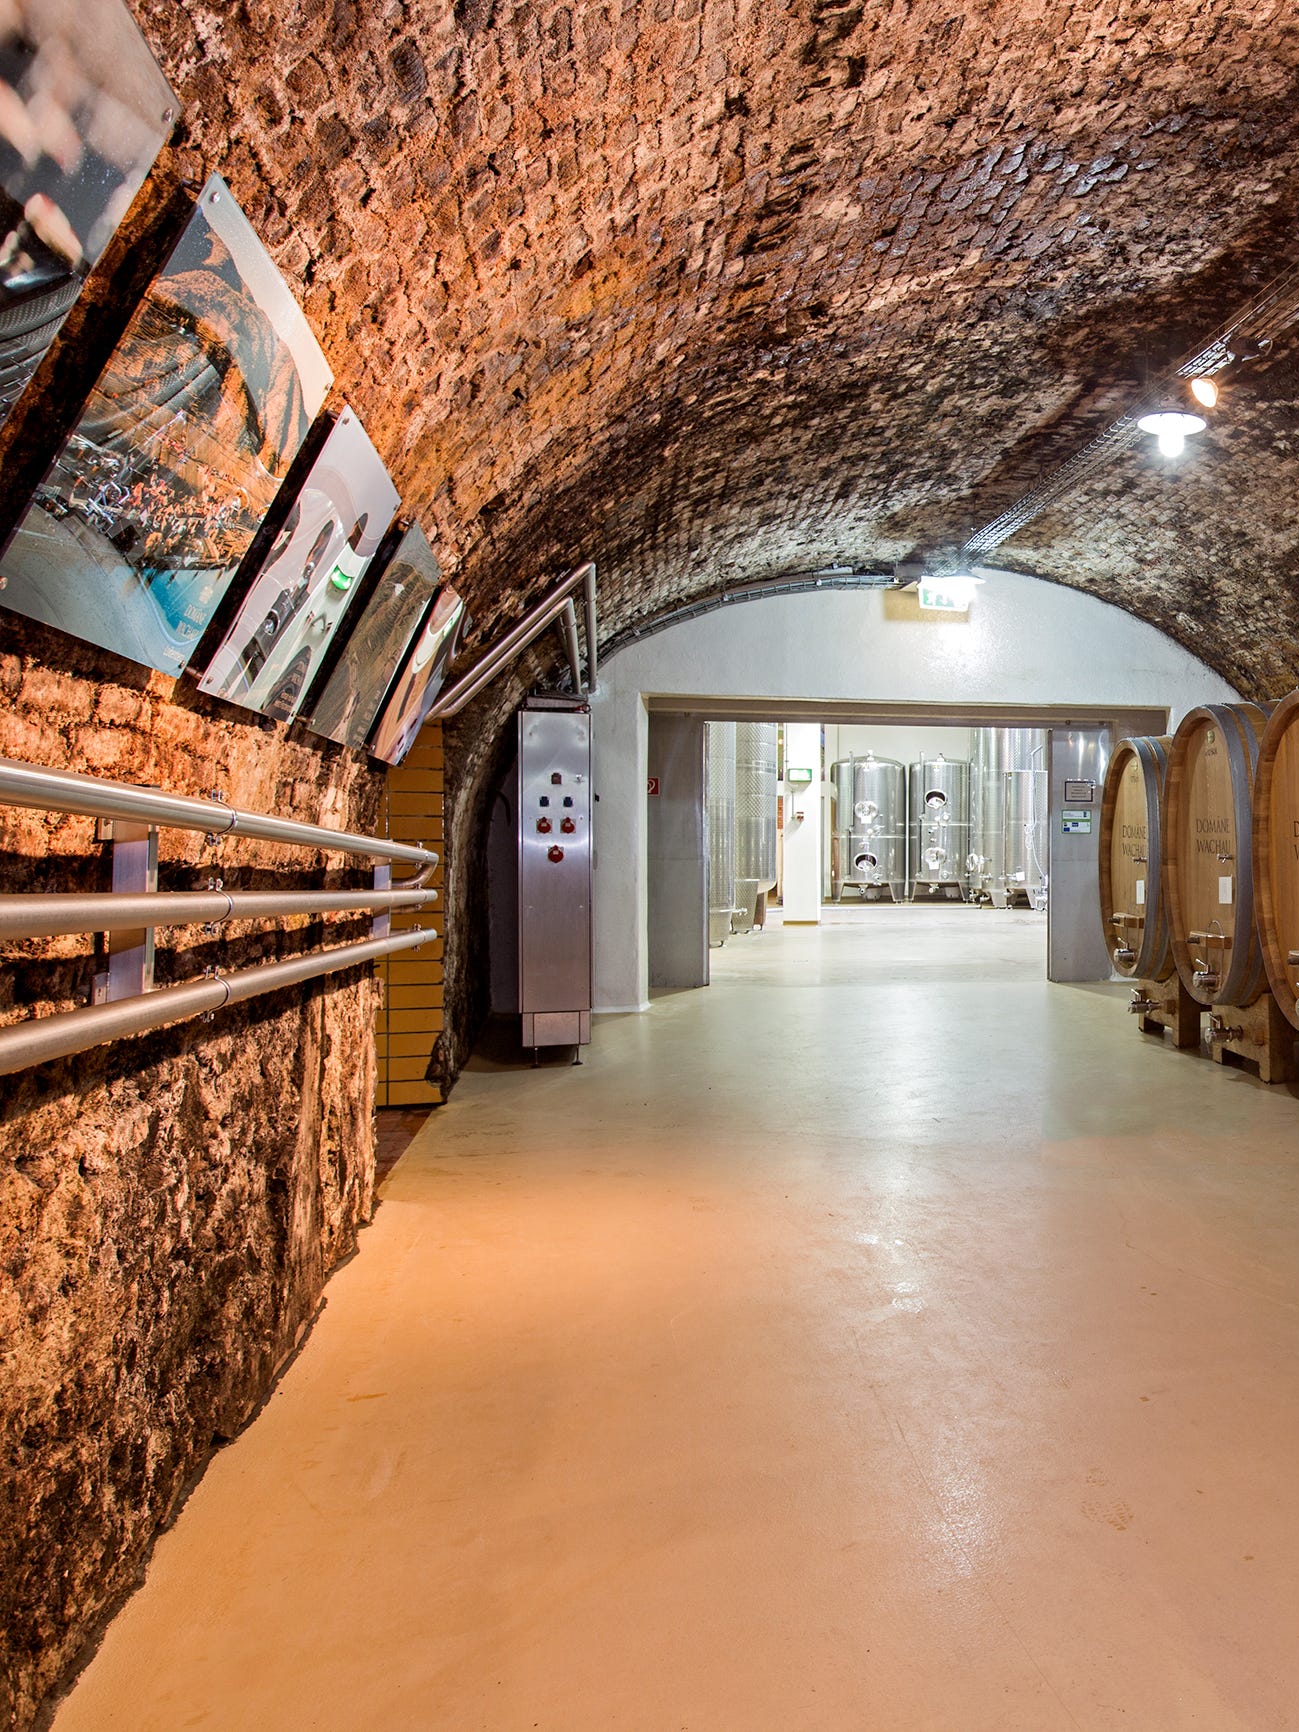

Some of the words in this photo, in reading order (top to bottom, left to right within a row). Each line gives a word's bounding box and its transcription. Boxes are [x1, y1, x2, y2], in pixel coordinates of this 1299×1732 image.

[1122, 824, 1147, 840] DOMÄNE
[1196, 815, 1230, 834] DOMÄNE
[1195, 839, 1231, 854] WACHAU
